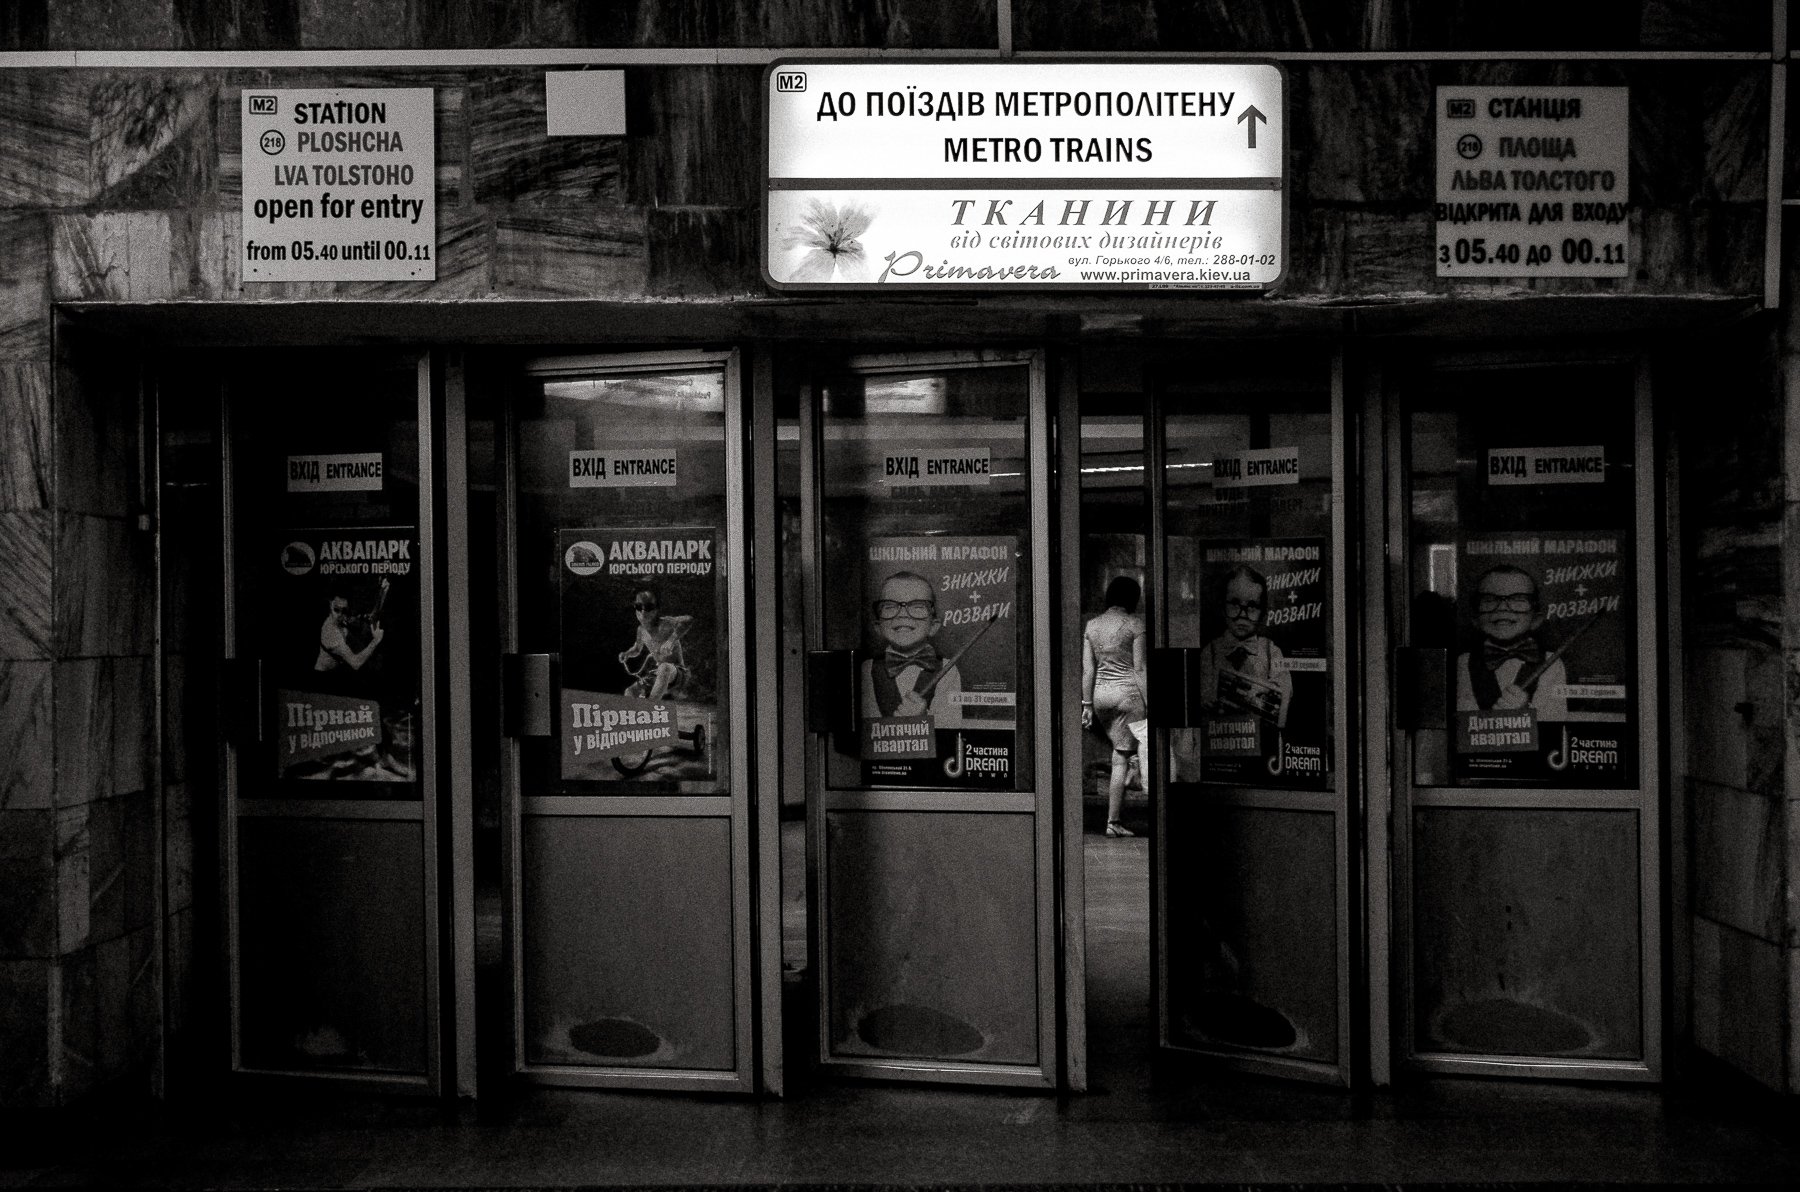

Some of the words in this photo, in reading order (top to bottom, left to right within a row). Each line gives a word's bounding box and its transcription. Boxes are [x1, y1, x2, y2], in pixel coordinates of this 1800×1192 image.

[294, 102, 386, 124] STATION
[817, 91, 856, 121] ДО
[866, 85, 985, 121] ПОЇЗДІВ
[995, 91, 1236, 117] МЕТРОПОЛІТЕНУ
[1488, 98, 1581, 122] СТАНЦІЯ
[263, 137, 282, 148] 218
[297, 131, 404, 152] PLOSHCHA
[944, 137, 1042, 163] METRO
[1050, 137, 1153, 163] TRAINS
[1461, 141, 1479, 152] 218
[1500, 137, 1577, 162] ПЛОЩА
[274, 164, 309, 186] LVA
[312, 164, 414, 186] TOLSTOHO
[1451, 170, 1507, 191] ЛЬВА
[1510, 170, 1615, 191] ТОЛСТОГО
[254, 198, 314, 224] open
[320, 192, 355, 218] for
[361, 193, 424, 224] entry
[950, 199, 1218, 226] ТКАНИНИ
[1435, 202, 1521, 225] ВІДКРИТА
[1528, 202, 1564, 225] ДЛЯ
[1572, 202, 1631, 225] ВХОДУ
[246, 240, 287, 260] from
[291, 240, 338, 261] 05.40
[341, 240, 381, 261] until
[384, 240, 431, 261] 00.11
[950, 230, 982, 249] від
[989, 230, 1093, 249] світових
[1098, 230, 1223, 255] дизайнерів
[1455, 238, 1520, 264] 05.40
[1562, 238, 1625, 264] 00.11
[877, 250, 1062, 283] Primavera
[1068, 256, 1092, 267] вул.
[1095, 255, 1151, 267] Горького
[1154, 255, 1173, 267] 4/6,
[1177, 256, 1209, 266] тел.:
[1213, 254, 1276, 266] 288-01-02
[1080, 268, 1251, 283] www.primavera.kiev.ua
[290, 461, 320, 483] ВХІД
[326, 462, 381, 479] ENTRANCE
[573, 457, 606, 480] ВХІД
[614, 458, 675, 476] ENTRANCE
[886, 457, 919, 479] ВХІД
[927, 458, 988, 475] ENTRANCE
[1213, 458, 1242, 480] ВХІД
[1247, 458, 1298, 476] ENTRANCE
[1490, 456, 1527, 478] ВХІД
[1535, 457, 1602, 474] ENTRANCE
[319, 540, 411, 560] АКВАПАРК
[609, 539, 712, 561] АКВАПАРК
[869, 544, 937, 561] ШКІЛЬНИЙ
[941, 545, 1008, 561] МАРАФОН
[1264, 546, 1320, 561] МАРАФОН
[1544, 539, 1617, 554] МАРАФОН
[319, 563, 369, 575] ЮРСЬКОГО
[371, 561, 411, 576] ПЕРІОДУ
[609, 562, 664, 575] ЮРСЬКОГО
[666, 562, 712, 576] ПЕРІОДУ
[941, 566, 1010, 592] ЗНИЖКИ
[1266, 566, 1321, 592] ЗНИЖКИ
[1544, 560, 1618, 585] ЗНИЖКИ
[943, 602, 1011, 627] РОЗВАГИ
[1266, 602, 1322, 627] РОЗВАГИ
[1546, 595, 1620, 620] РОЗВАГИ
[287, 702, 373, 731] Пірнай
[571, 703, 669, 731] Пірнай
[1208, 719, 1256, 736] Дитячий
[1468, 713, 1531, 732] Дитячий
[871, 720, 930, 739] Дитячий
[1470, 731, 1531, 746] квартал
[873, 738, 929, 754] квартал
[965, 744, 973, 755] 2
[973, 746, 1009, 756] частина
[1210, 737, 1255, 750] квартал
[1285, 742, 1291, 754] 2
[1291, 746, 1321, 756] частина
[1571, 736, 1578, 748] 2
[1578, 739, 1618, 749] частина
[965, 757, 1009, 772] DREAM
[1285, 756, 1321, 771] DREAM
[1571, 750, 1618, 764] DREAM
